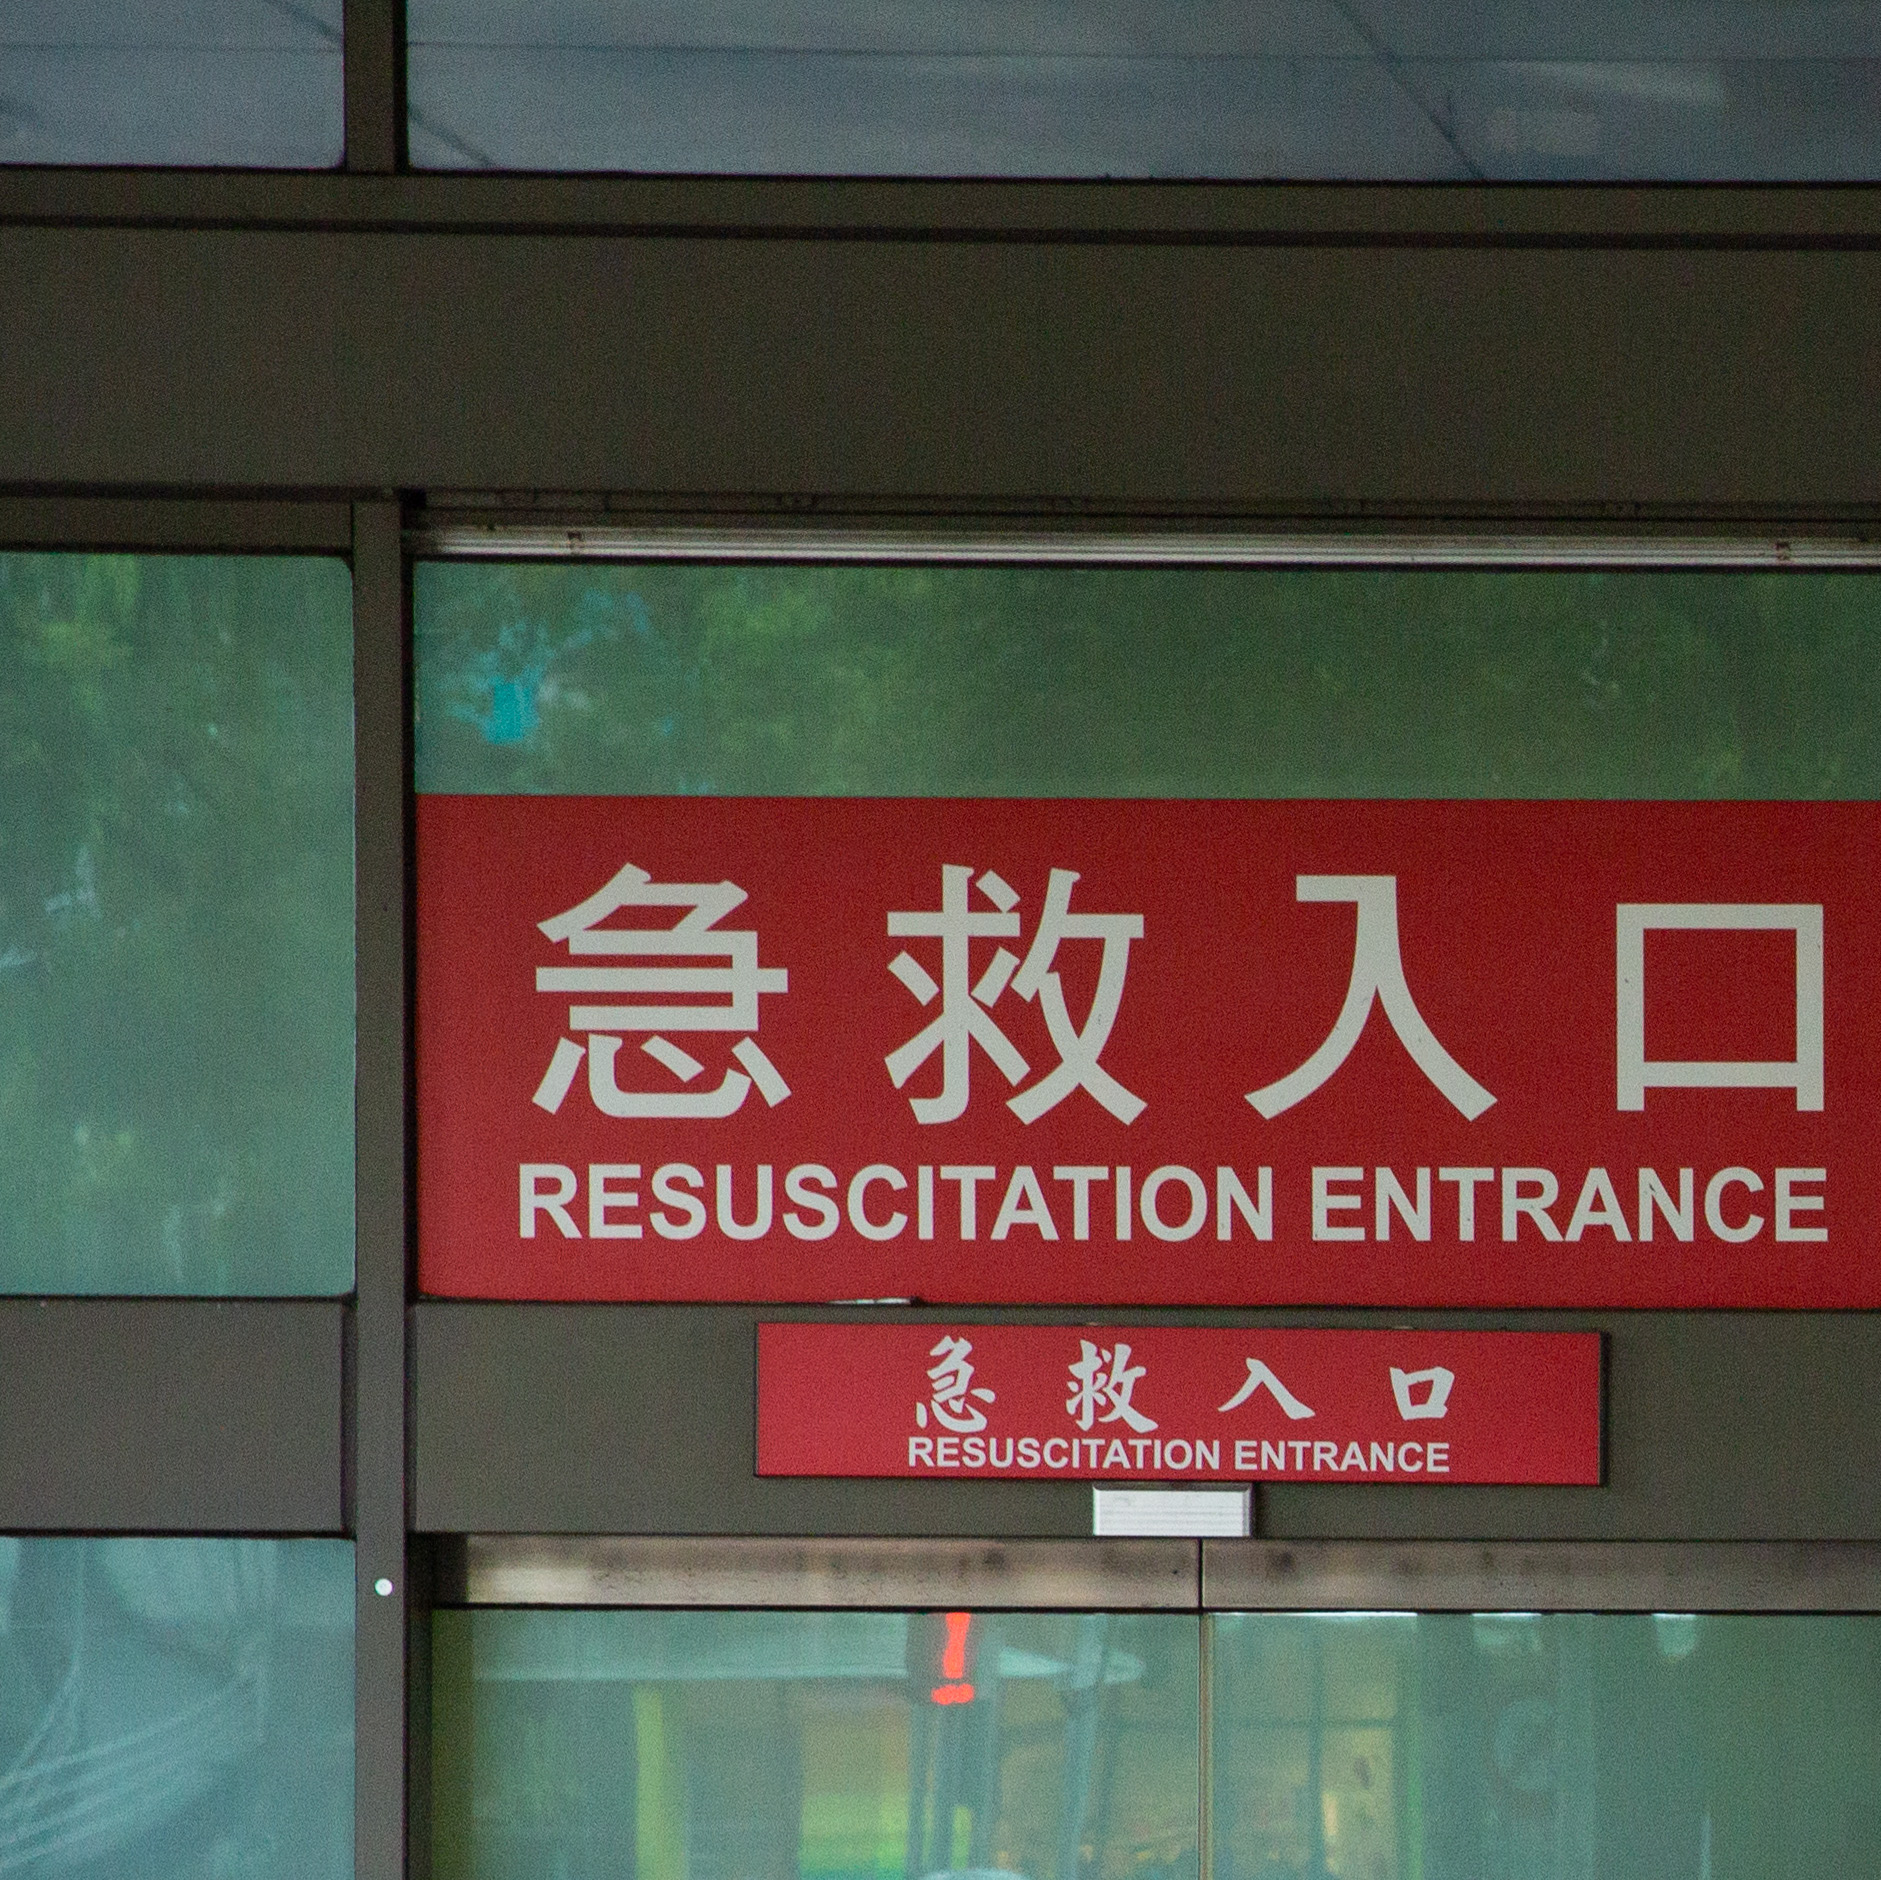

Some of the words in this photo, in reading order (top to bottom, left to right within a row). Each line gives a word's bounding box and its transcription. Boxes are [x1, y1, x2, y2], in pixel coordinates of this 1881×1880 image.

[533, 863, 1824, 1125] 急救入口
[519, 1163, 1273, 1242] RESUSCITATION
[1311, 1166, 1828, 1242] ENTRANCE
[916, 1335, 1455, 1433] 急救入口
[908, 1437, 1220, 1470] RESUSCITATION
[1234, 1440, 1450, 1473] ENTRANCE
